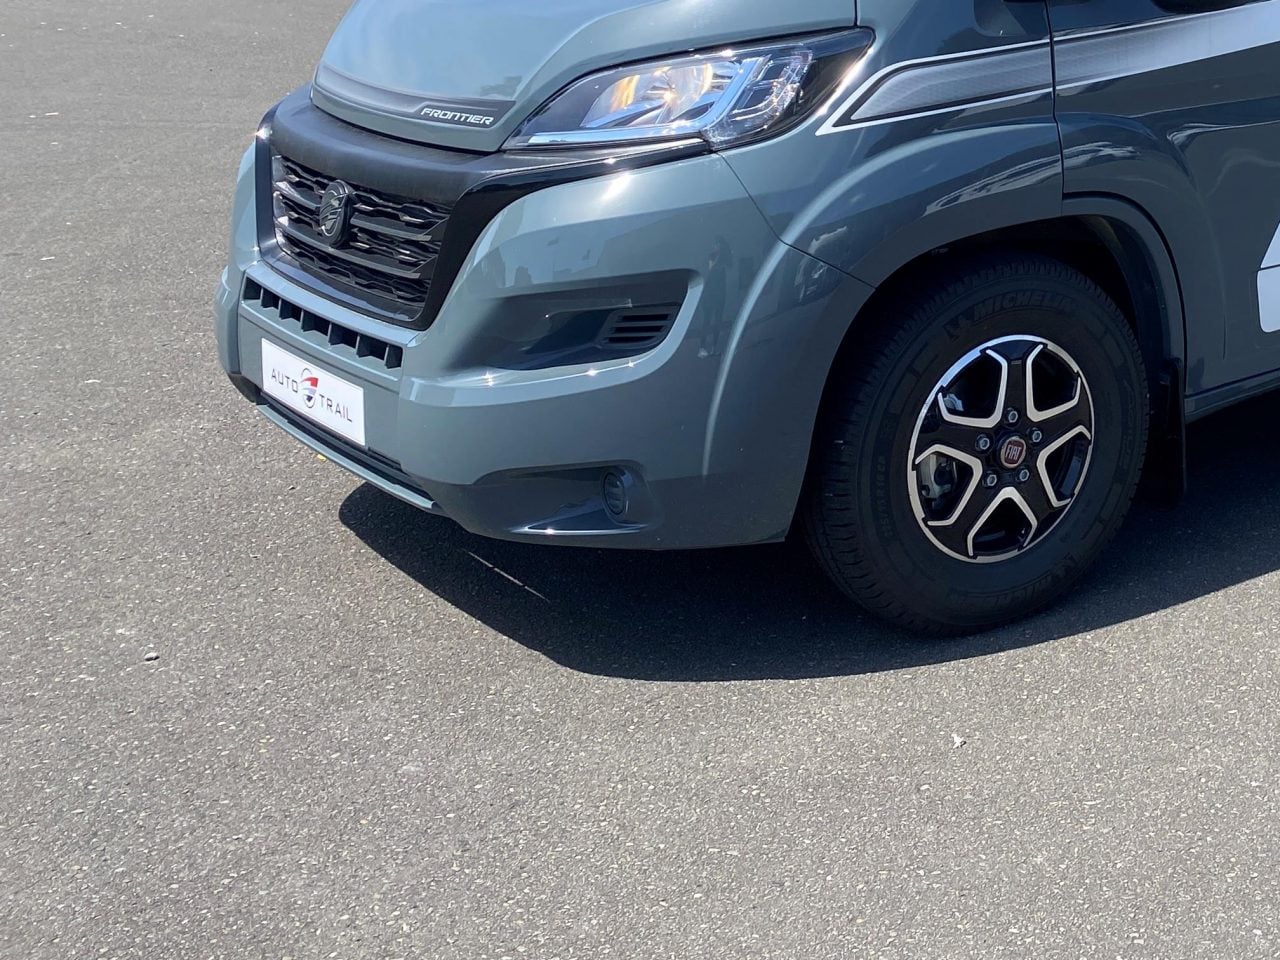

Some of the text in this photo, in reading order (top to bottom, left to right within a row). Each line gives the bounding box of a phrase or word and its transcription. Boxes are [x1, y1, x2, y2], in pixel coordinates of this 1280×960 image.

[420, 108, 494, 125] FRONTIER
[271, 368, 353, 423] AUTO TRAIL
[1005, 444, 1022, 460] FIAT
